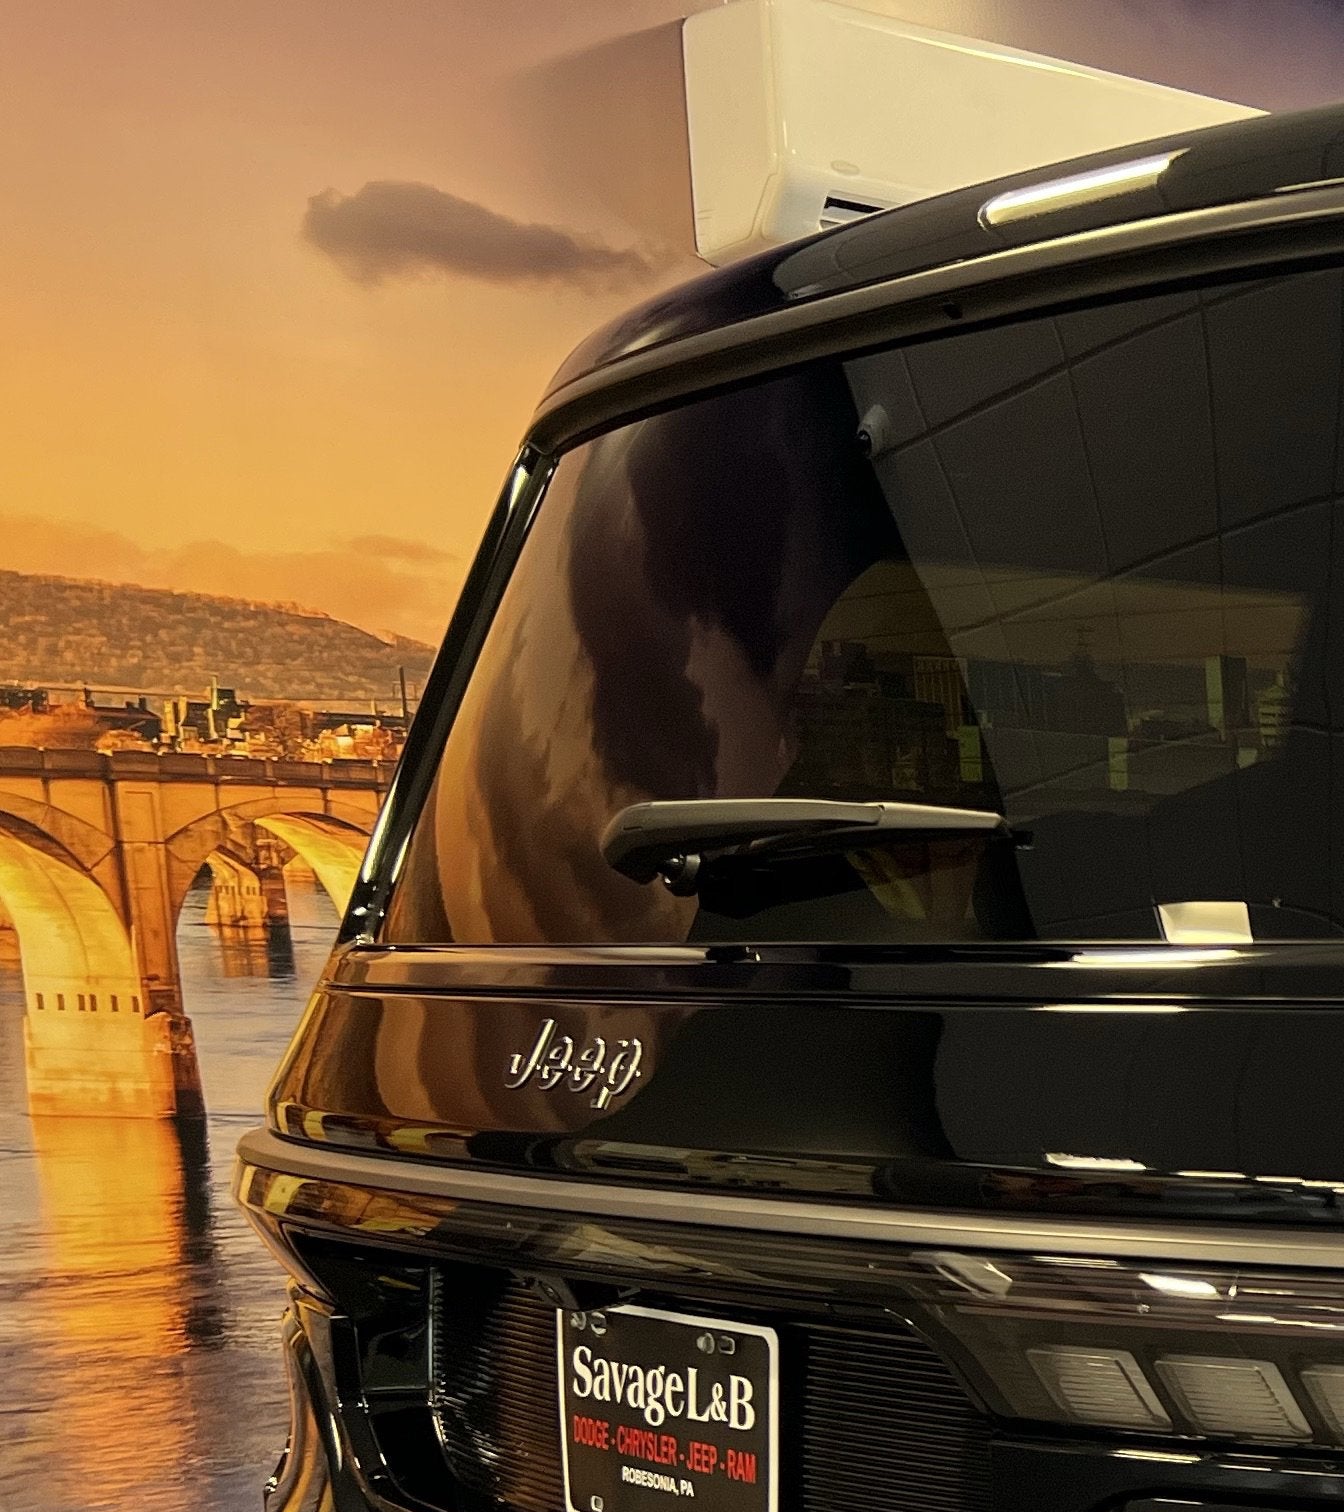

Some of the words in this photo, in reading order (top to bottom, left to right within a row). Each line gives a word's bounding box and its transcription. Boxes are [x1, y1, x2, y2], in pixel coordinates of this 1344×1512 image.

[504, 1018, 643, 1110] Jeep
[573, 1415, 610, 1450] DODGE
[616, 1425, 678, 1467] CHRYSLER
[686, 1442, 718, 1475] JEEP
[727, 1449, 756, 1484] RAM
[621, 1465, 680, 1495] ROBESONIA,
[680, 1478, 695, 1497] PA
